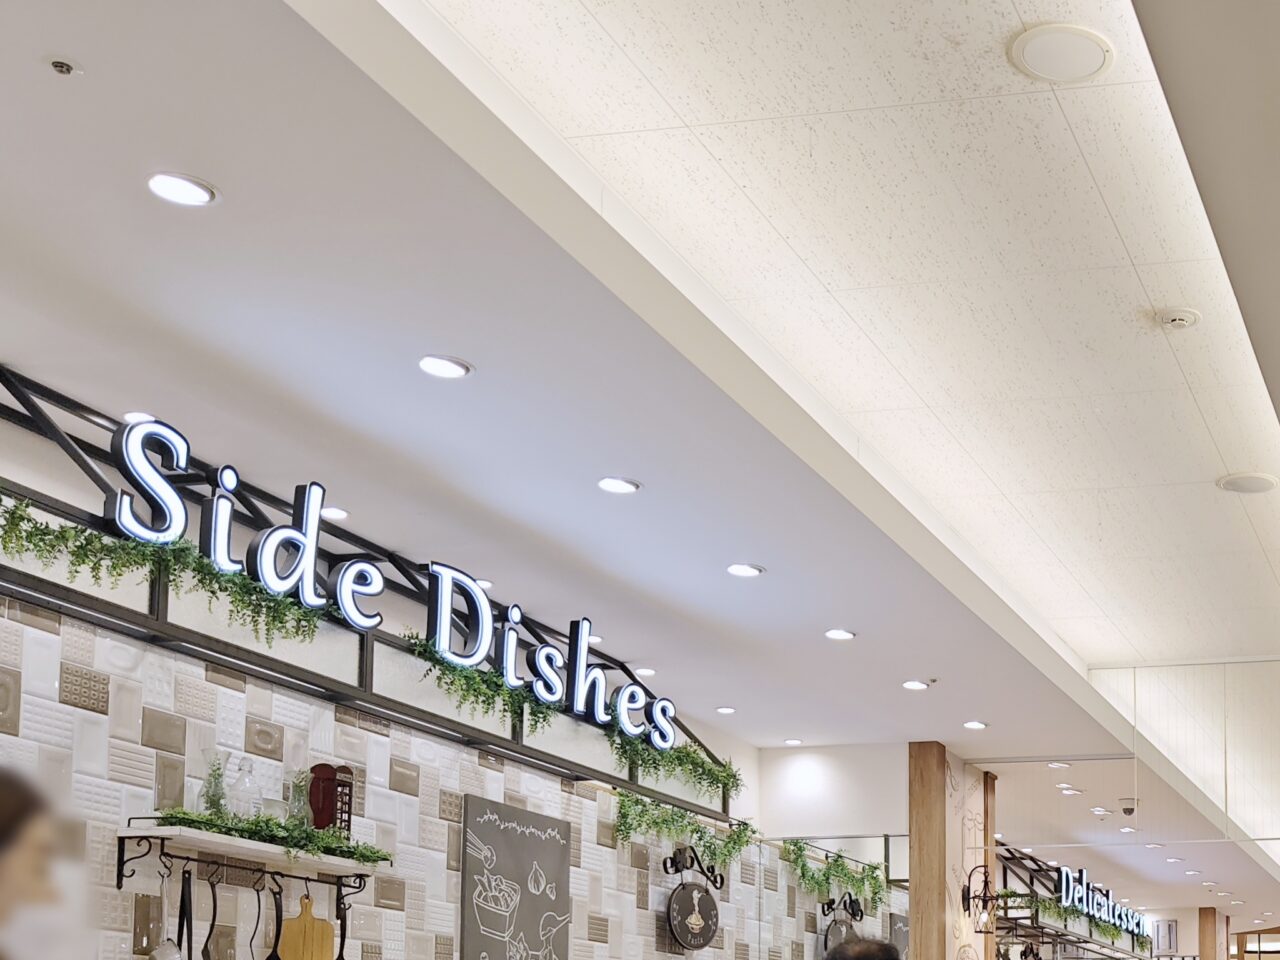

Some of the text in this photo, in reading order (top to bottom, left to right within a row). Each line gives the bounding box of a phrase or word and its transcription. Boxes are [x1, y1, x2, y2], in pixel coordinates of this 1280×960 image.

[112, 419, 678, 752] Side Dishes
[1060, 866, 1153, 937] Delicatessen
